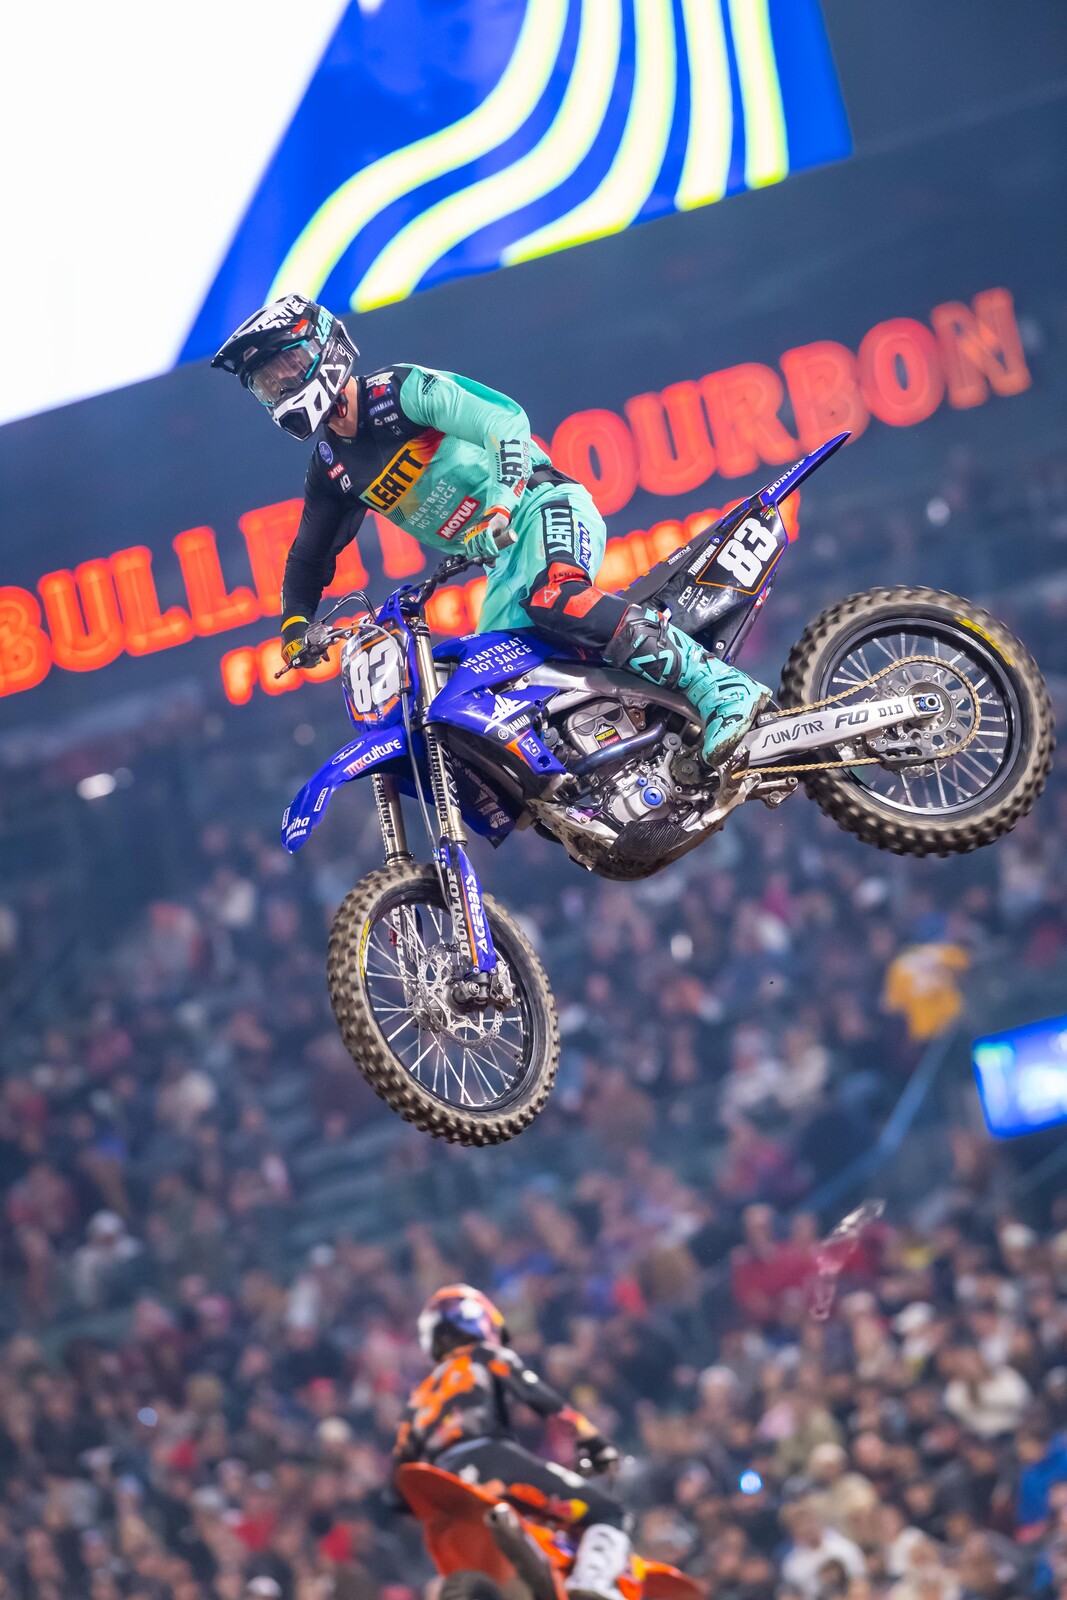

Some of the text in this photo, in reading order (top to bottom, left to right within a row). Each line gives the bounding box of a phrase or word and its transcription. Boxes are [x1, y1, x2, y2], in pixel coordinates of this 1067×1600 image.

[0, 498, 426, 698] BULLE
[530, 283, 1031, 518] OURBON
[364, 448, 424, 511] LEATT
[766, 458, 806, 496] DUNLOP
[408, 479, 448, 526] HEARTBEAT
[416, 485, 458, 530] HOT SAUCE
[440, 500, 477, 539] MOTUL
[544, 507, 573, 555] LEATT
[687, 543, 717, 576] THOMPSON
[716, 518, 778, 588] 83
[677, 586, 693, 606] FCP
[460, 637, 524, 669] HEARTBEAT
[470, 644, 533, 675] HOT SAUCE
[502, 663, 517, 673] CO.
[350, 638, 401, 713] 83
[506, 714, 531, 733] YAMAHA
[761, 720, 825, 749] SUNSTAR
[834, 709, 869, 730] FLO
[343, 738, 402, 776] mxculture
[447, 868, 471, 958] DUNLOP
[465, 874, 489, 955] ACERBIS
